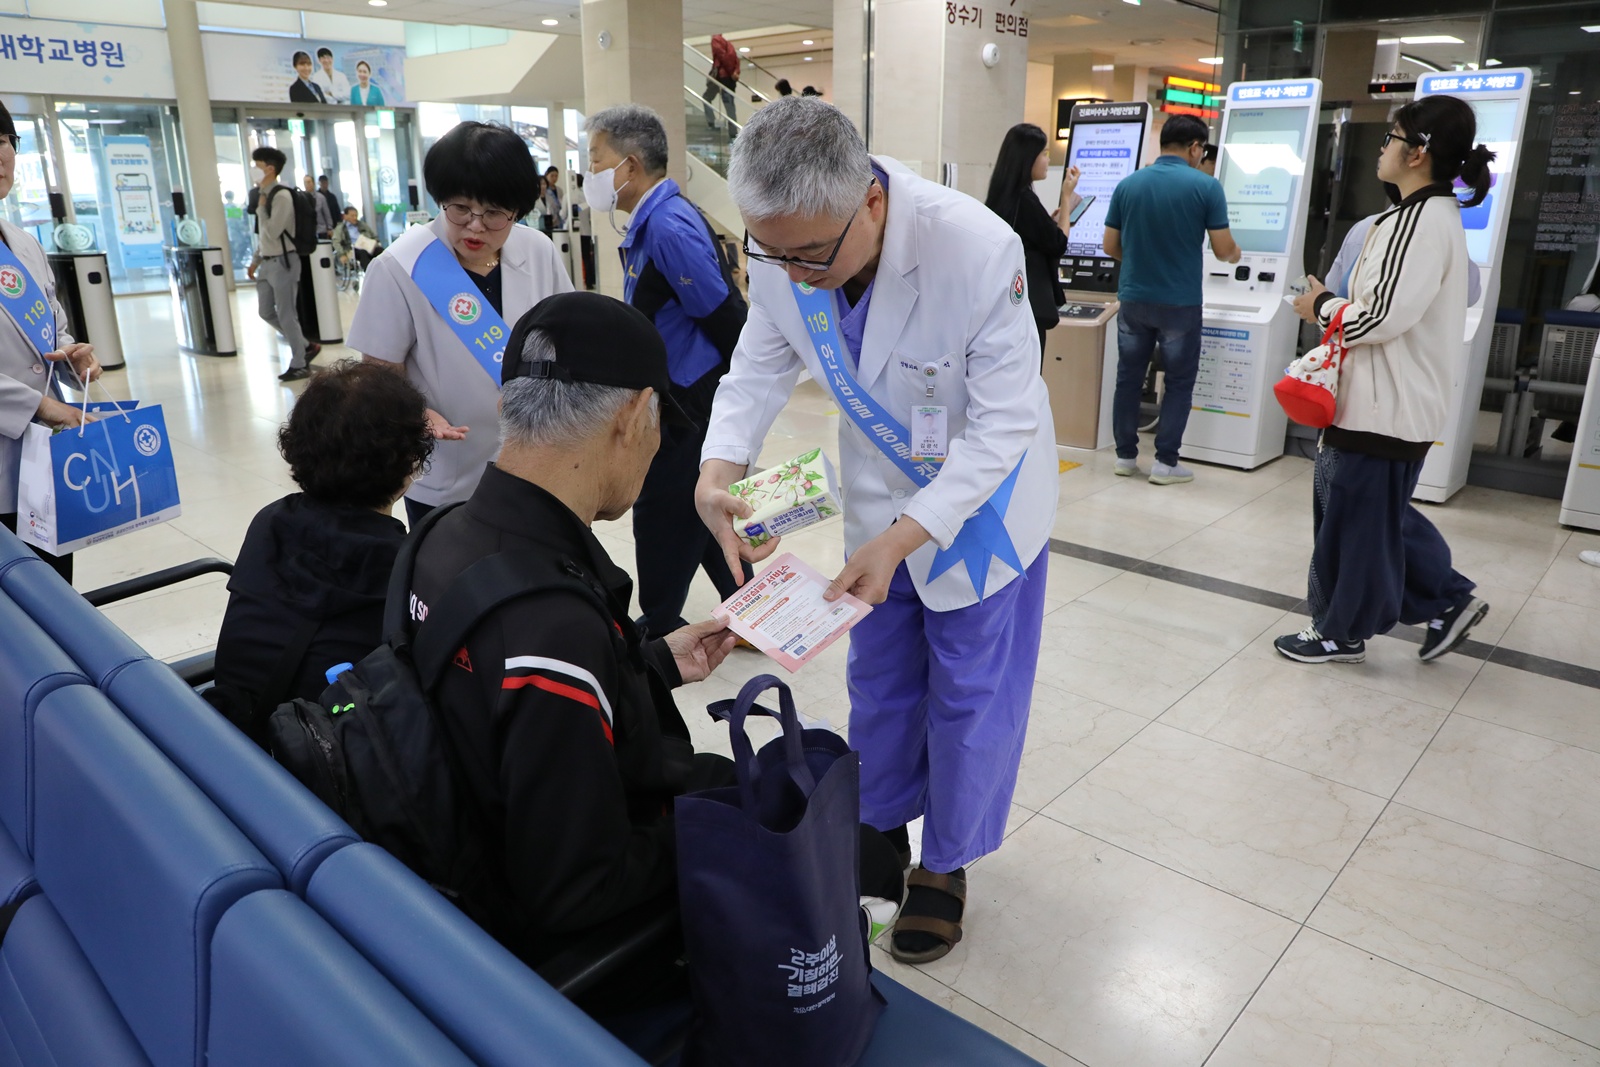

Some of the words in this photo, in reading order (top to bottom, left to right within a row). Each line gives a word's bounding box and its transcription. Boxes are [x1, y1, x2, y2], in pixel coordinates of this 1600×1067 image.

[946, 1, 982, 29] 정수기
[995, 12, 1029, 38] 편의점
[24, 300, 46, 326] 119
[808, 311, 829, 334] 119
[475, 325, 504, 350] 119
[728, 601, 744, 614] 119
[1321, 640, 1339, 653] N
